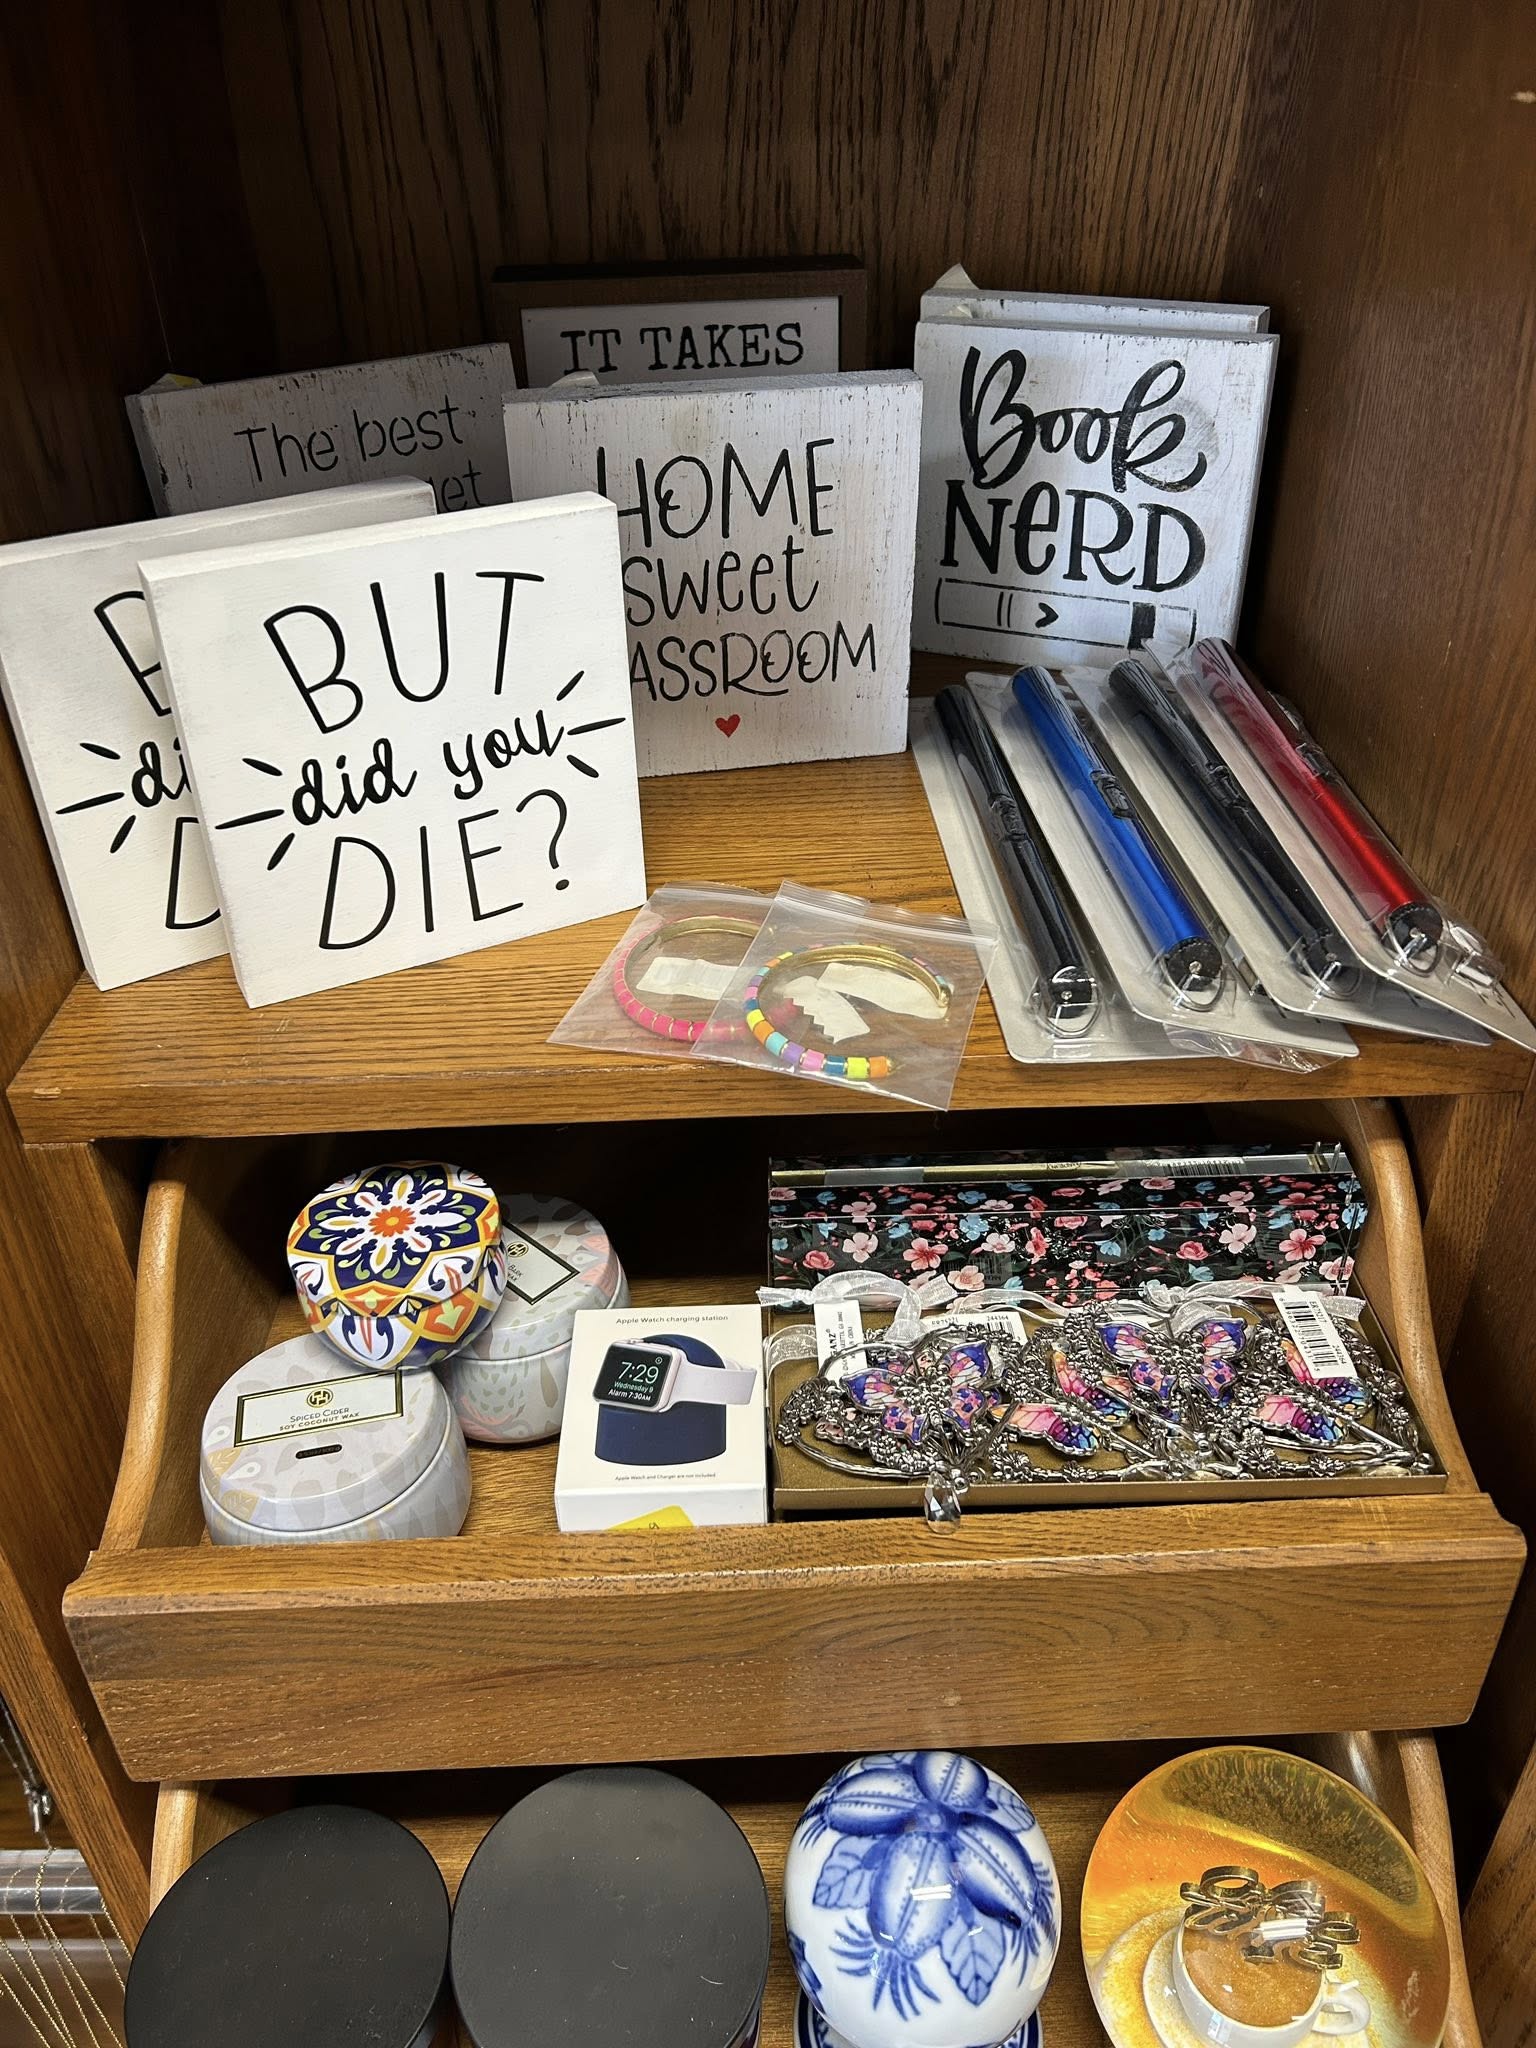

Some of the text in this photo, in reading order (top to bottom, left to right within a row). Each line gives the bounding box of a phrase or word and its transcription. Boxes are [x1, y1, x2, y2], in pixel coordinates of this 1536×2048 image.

[560, 322, 805, 376] IT TAKES
[234, 394, 463, 481] The best
[960, 346, 1207, 492] Book
[597, 438, 835, 547] HOME
[263, 571, 544, 734] BUT
[631, 623, 877, 701] ASSROOM
[292, 709, 563, 827] did you
[319, 789, 569, 950] DIE?
[616, 1317, 639, 1325] Apple
[666, 1315, 700, 1323] charging
[608, 1388, 628, 1398] Alarm
[614, 1381, 648, 1393] Wednesday
[618, 1361, 659, 1384] 7:29
[290, 1407, 350, 1423] SPICED CIDER
[298, 1416, 339, 1428] COCONUT
[341, 1412, 360, 1421] WAX
